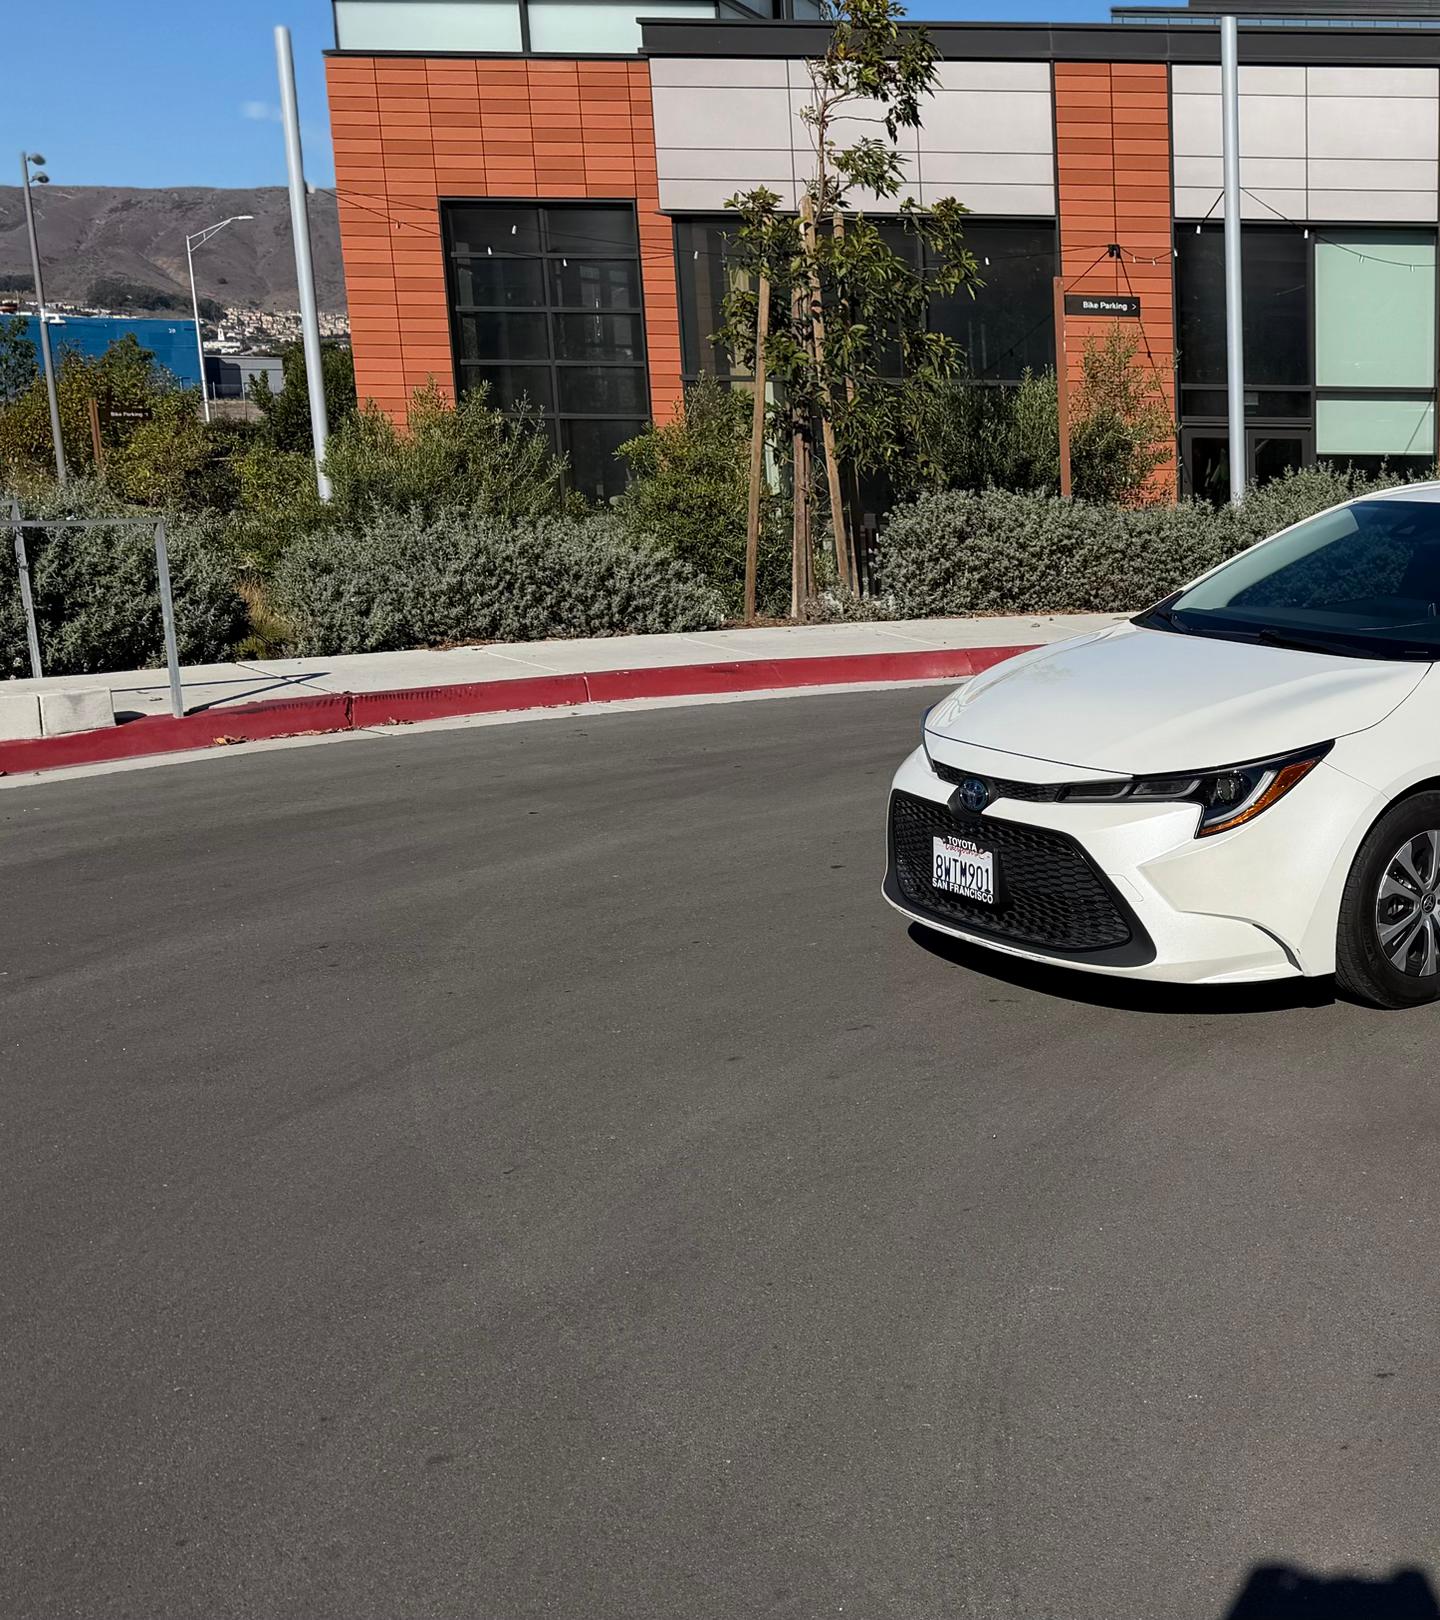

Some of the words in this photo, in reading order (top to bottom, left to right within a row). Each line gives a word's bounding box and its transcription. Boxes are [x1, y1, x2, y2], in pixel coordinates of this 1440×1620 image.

[1083, 301, 1099, 309] Bike
[1100, 302, 1128, 311] Parking
[947, 836, 977, 851] TOYOTA
[935, 854, 992, 894] 8WTM901
[932, 877, 948, 890] SAN
[949, 882, 993, 904] FRANCISCO
